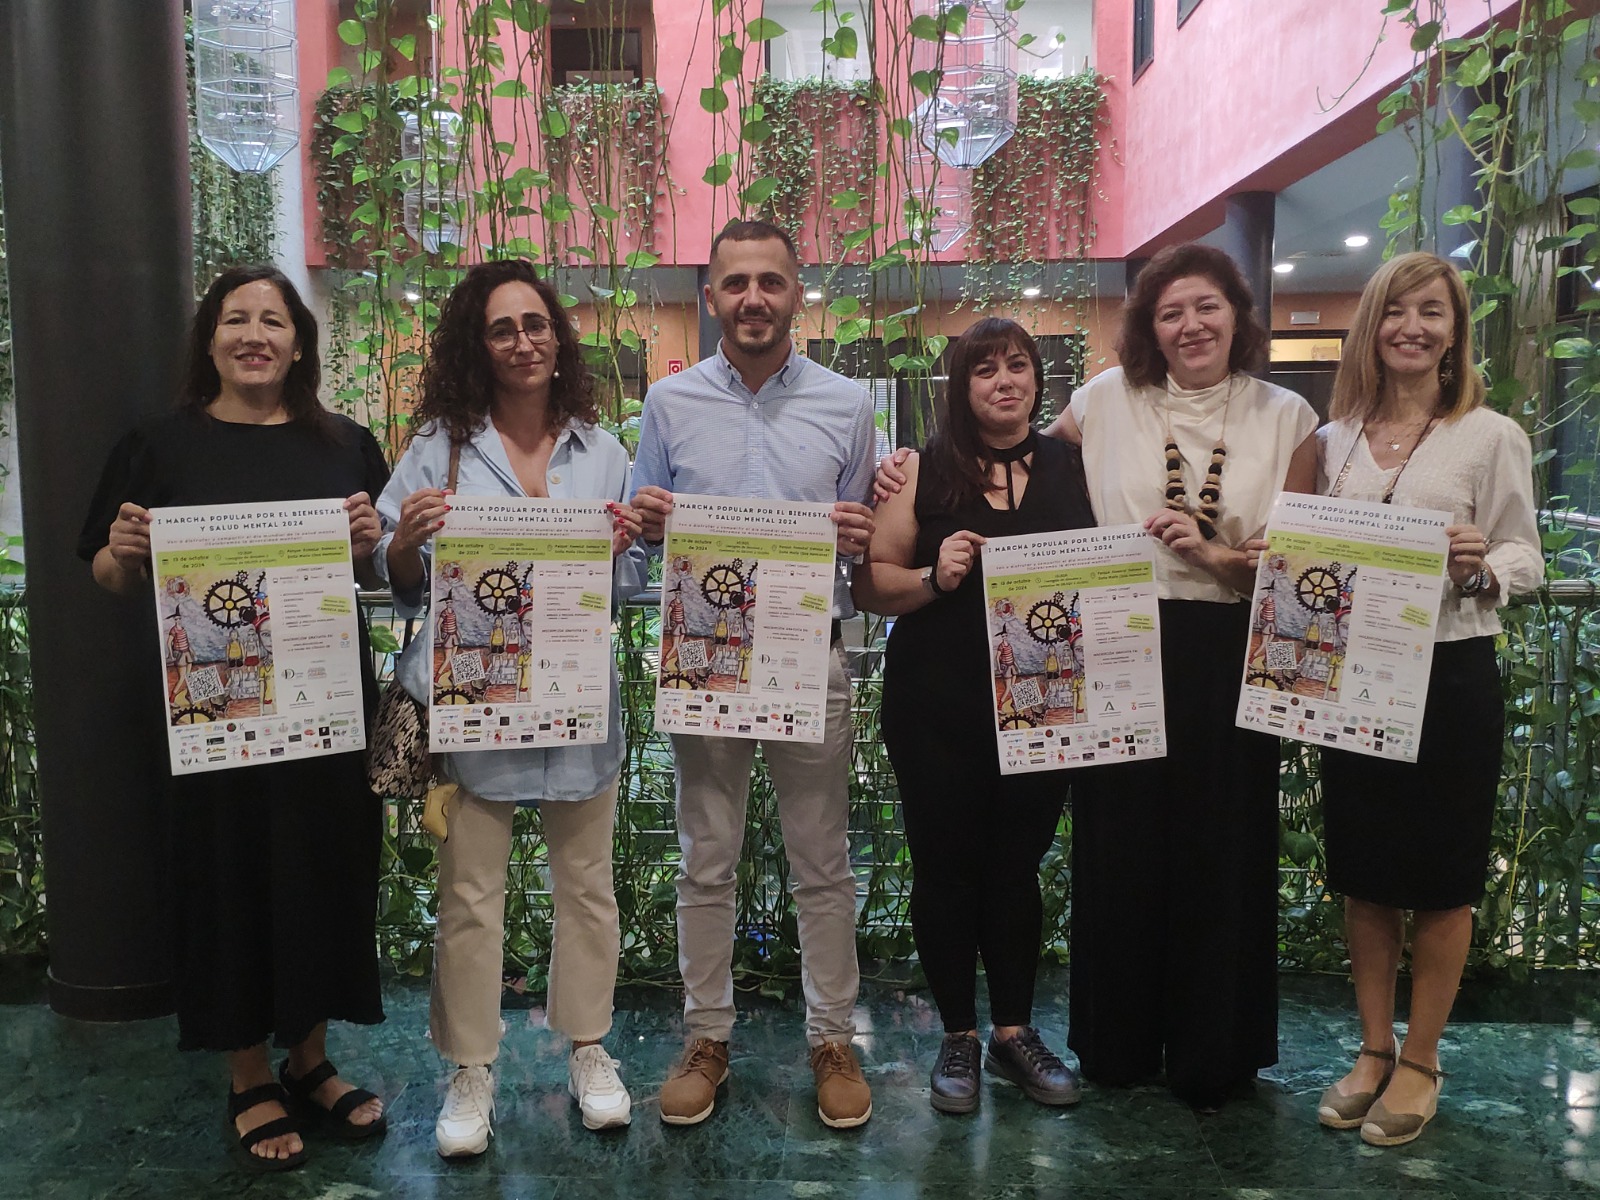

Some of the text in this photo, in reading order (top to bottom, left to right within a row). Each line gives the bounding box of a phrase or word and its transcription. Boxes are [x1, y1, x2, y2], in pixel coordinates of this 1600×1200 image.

[209, 513, 252, 521] POPULAR
[291, 508, 341, 516] BIENESTAR
[716, 505, 753, 513] POPULAR
[1284, 500, 1319, 511] MARCHA
[1320, 505, 1360, 516] POPULAR
[1362, 510, 1380, 518] POR
[1395, 515, 1446, 528] BIENESTAR
[1317, 514, 1345, 523] SALUD
[1347, 518, 1381, 528] MENTAL
[1383, 523, 1405, 532] 2024
[995, 543, 1028, 552] MARCHA
[1031, 539, 1068, 548] POPULAR
[1102, 531, 1146, 541] BIENESTAR
[1059, 546, 1090, 554] MENTAL
